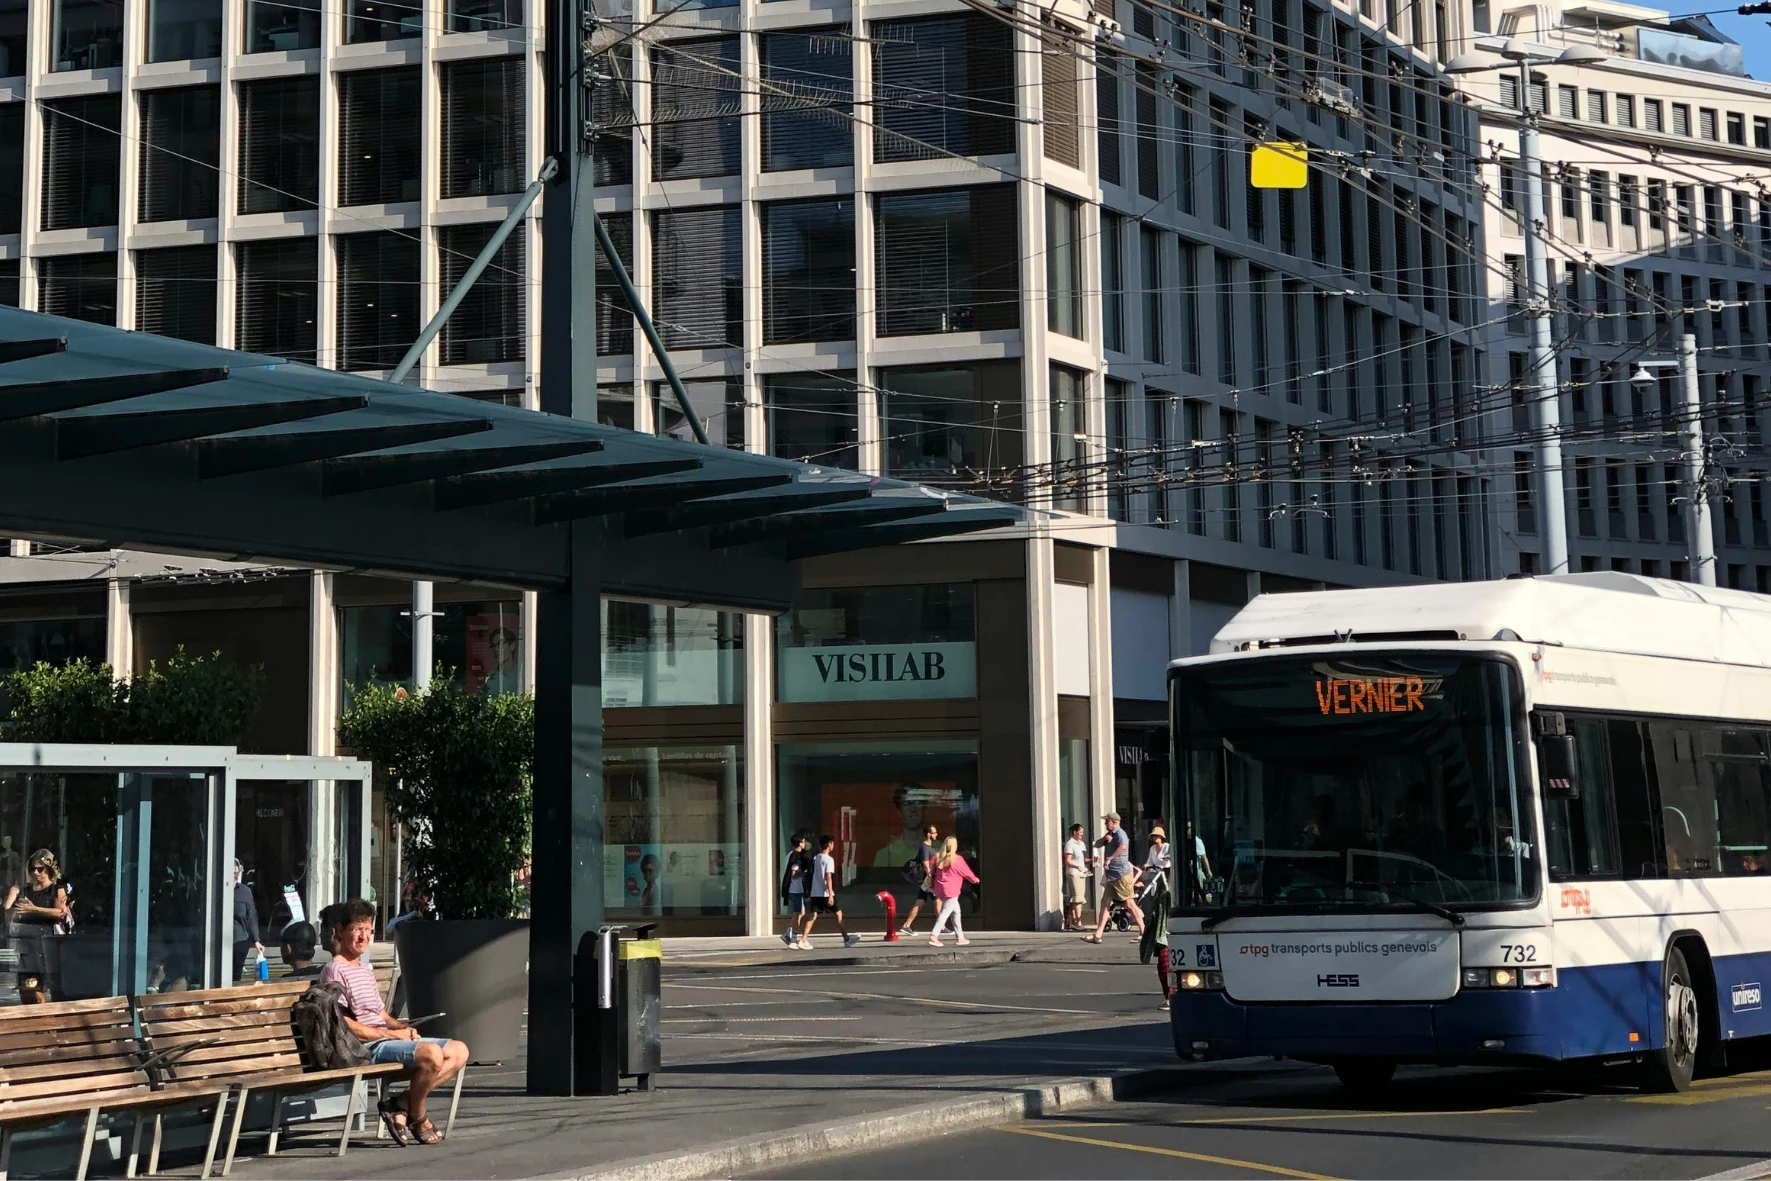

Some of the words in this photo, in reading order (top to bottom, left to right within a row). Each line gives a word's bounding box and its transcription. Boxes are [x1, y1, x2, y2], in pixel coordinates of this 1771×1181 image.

[812, 652, 945, 683] VISILAB
[1316, 675, 1424, 715] VERNIER
[1170, 949, 1186, 966] 32
[1271, 943, 1332, 956] transports
[1334, 941, 1378, 956] publics
[1381, 941, 1437, 956] genevois
[1500, 944, 1537, 963] 732
[1317, 974, 1360, 987] HESS
[1732, 988, 1760, 1006] unireso
